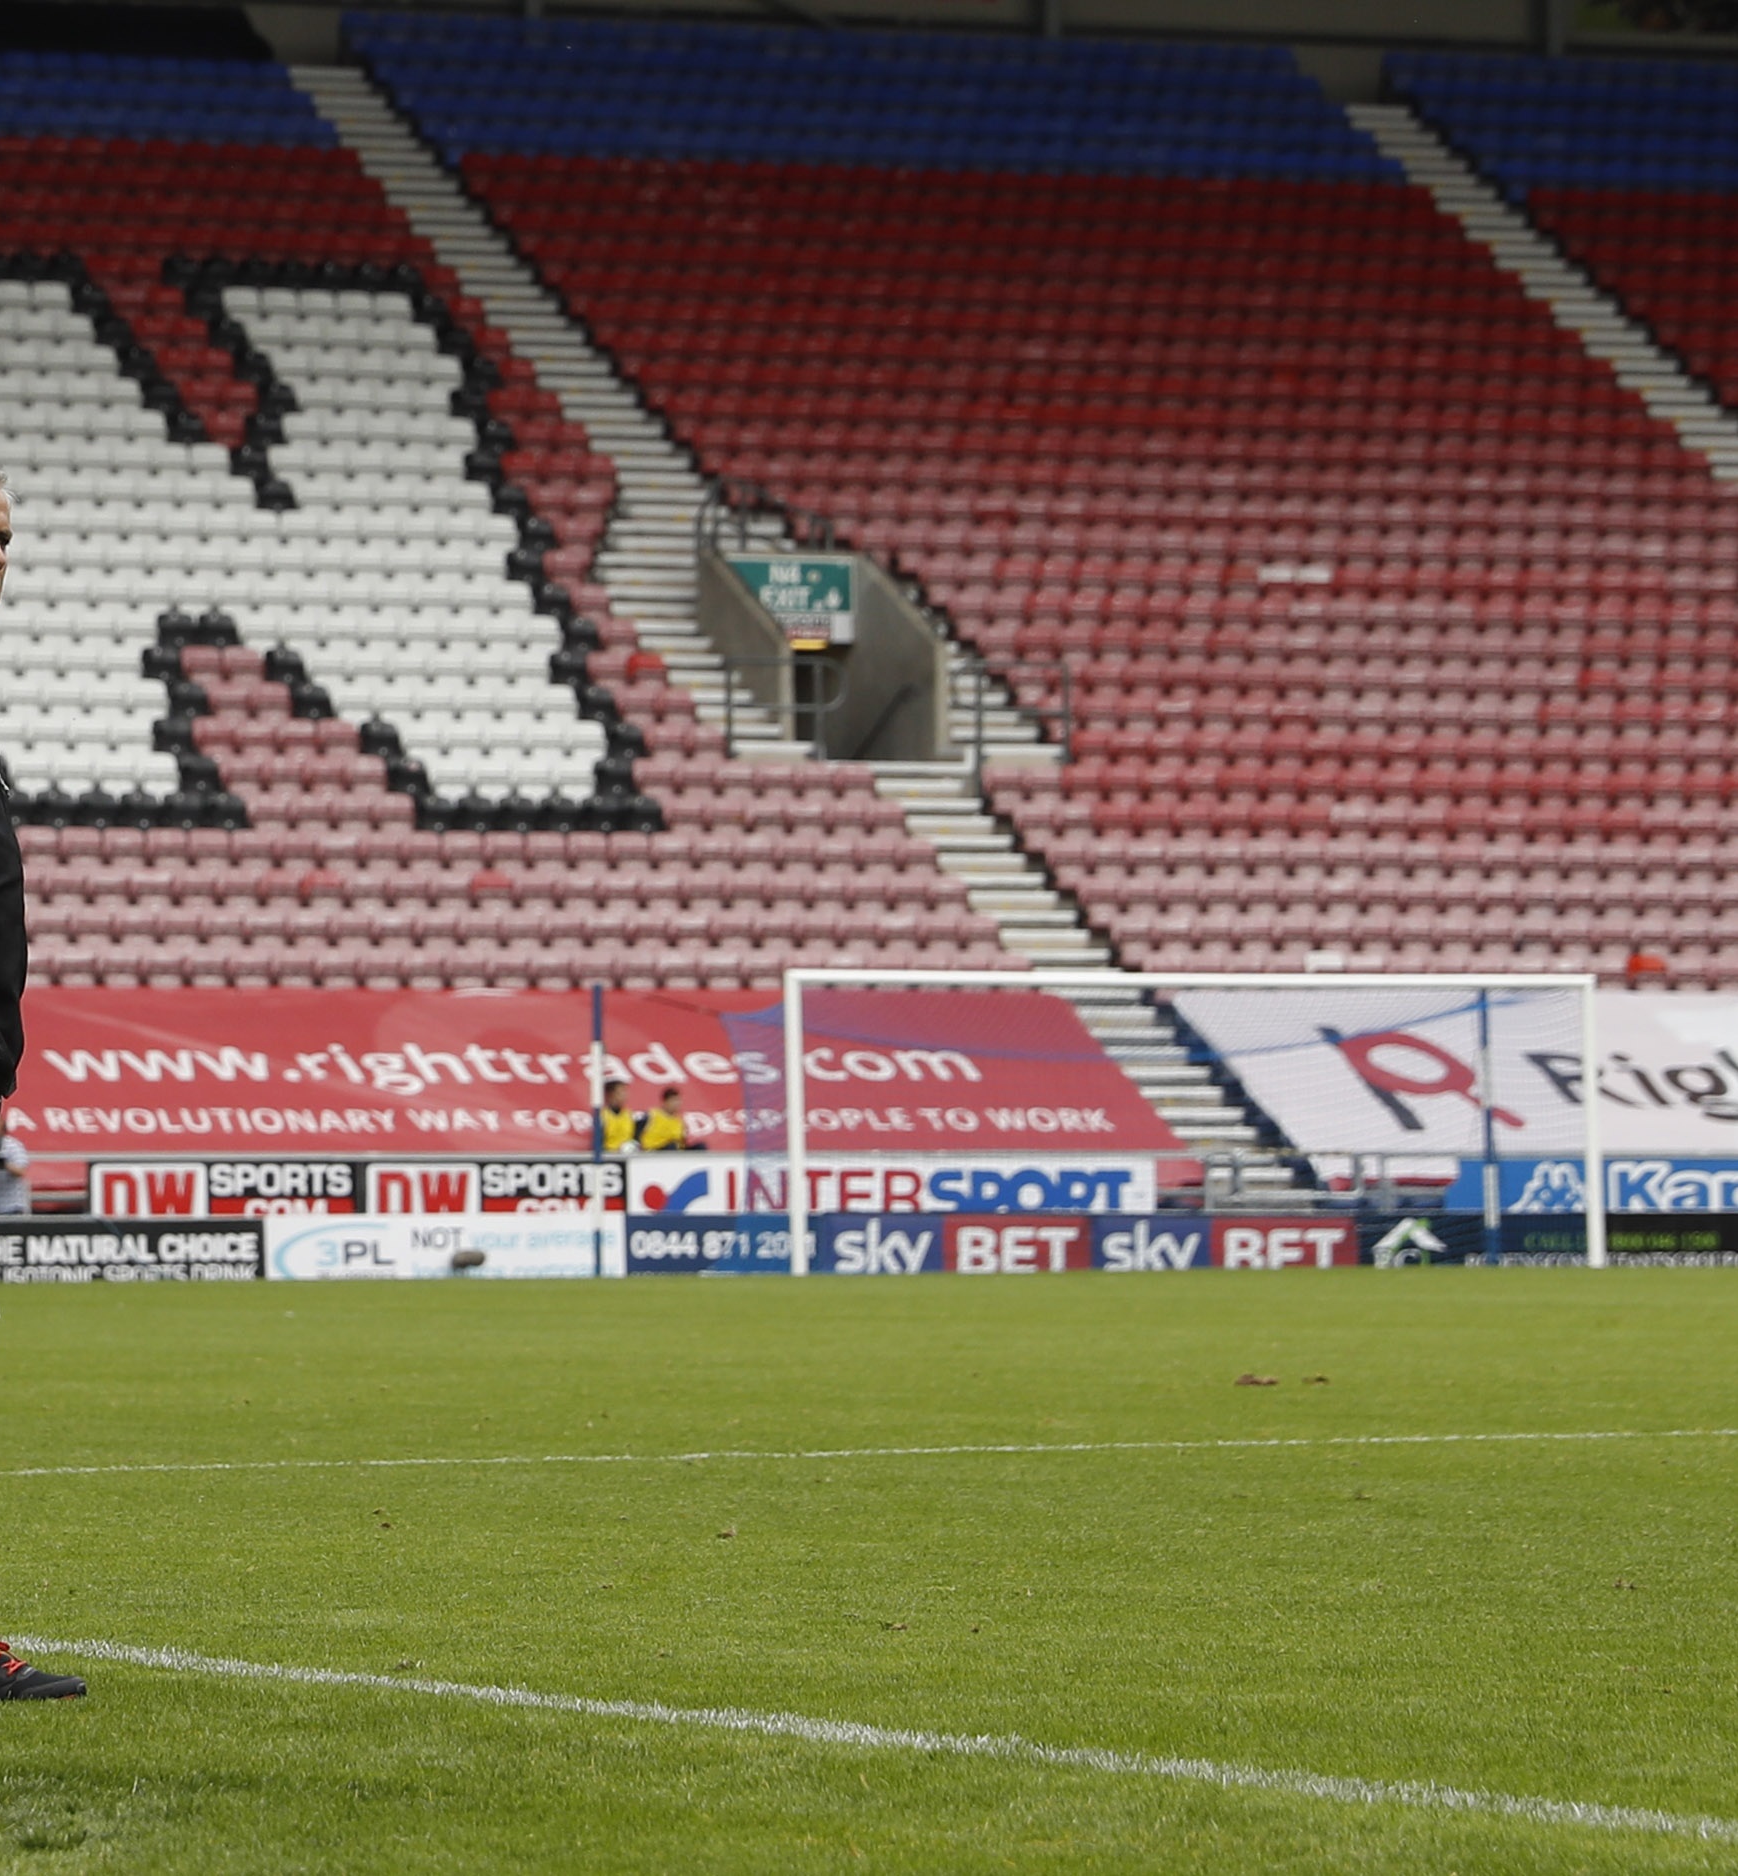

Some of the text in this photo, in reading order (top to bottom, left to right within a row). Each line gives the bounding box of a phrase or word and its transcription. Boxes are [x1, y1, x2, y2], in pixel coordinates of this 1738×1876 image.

[760, 584, 814, 610] EXIT
[41, 1042, 983, 1097] www.righttradescom
[1523, 1048, 1738, 1121] Rig
[6, 1107, 37, 1132] A
[43, 1106, 395, 1134] REVOLUTIONARY
[408, 1108, 500, 1133] WAY
[917, 1107, 980, 1132] TO
[985, 1107, 1116, 1133] WORK
[102, 1164, 352, 1216] DW SPORTS
[375, 1170, 470, 1214] DW
[25, 1234, 157, 1265] NATURAL
[158, 1233, 259, 1264] CHOICE
[316, 1240, 395, 1266] 3PL
[411, 1226, 465, 1250] NOT
[629, 1229, 699, 1260] 0844
[833, 1217, 1079, 1275] sky BET
[1101, 1219, 1201, 1272] sky
[1223, 1227, 1347, 1270] BET
